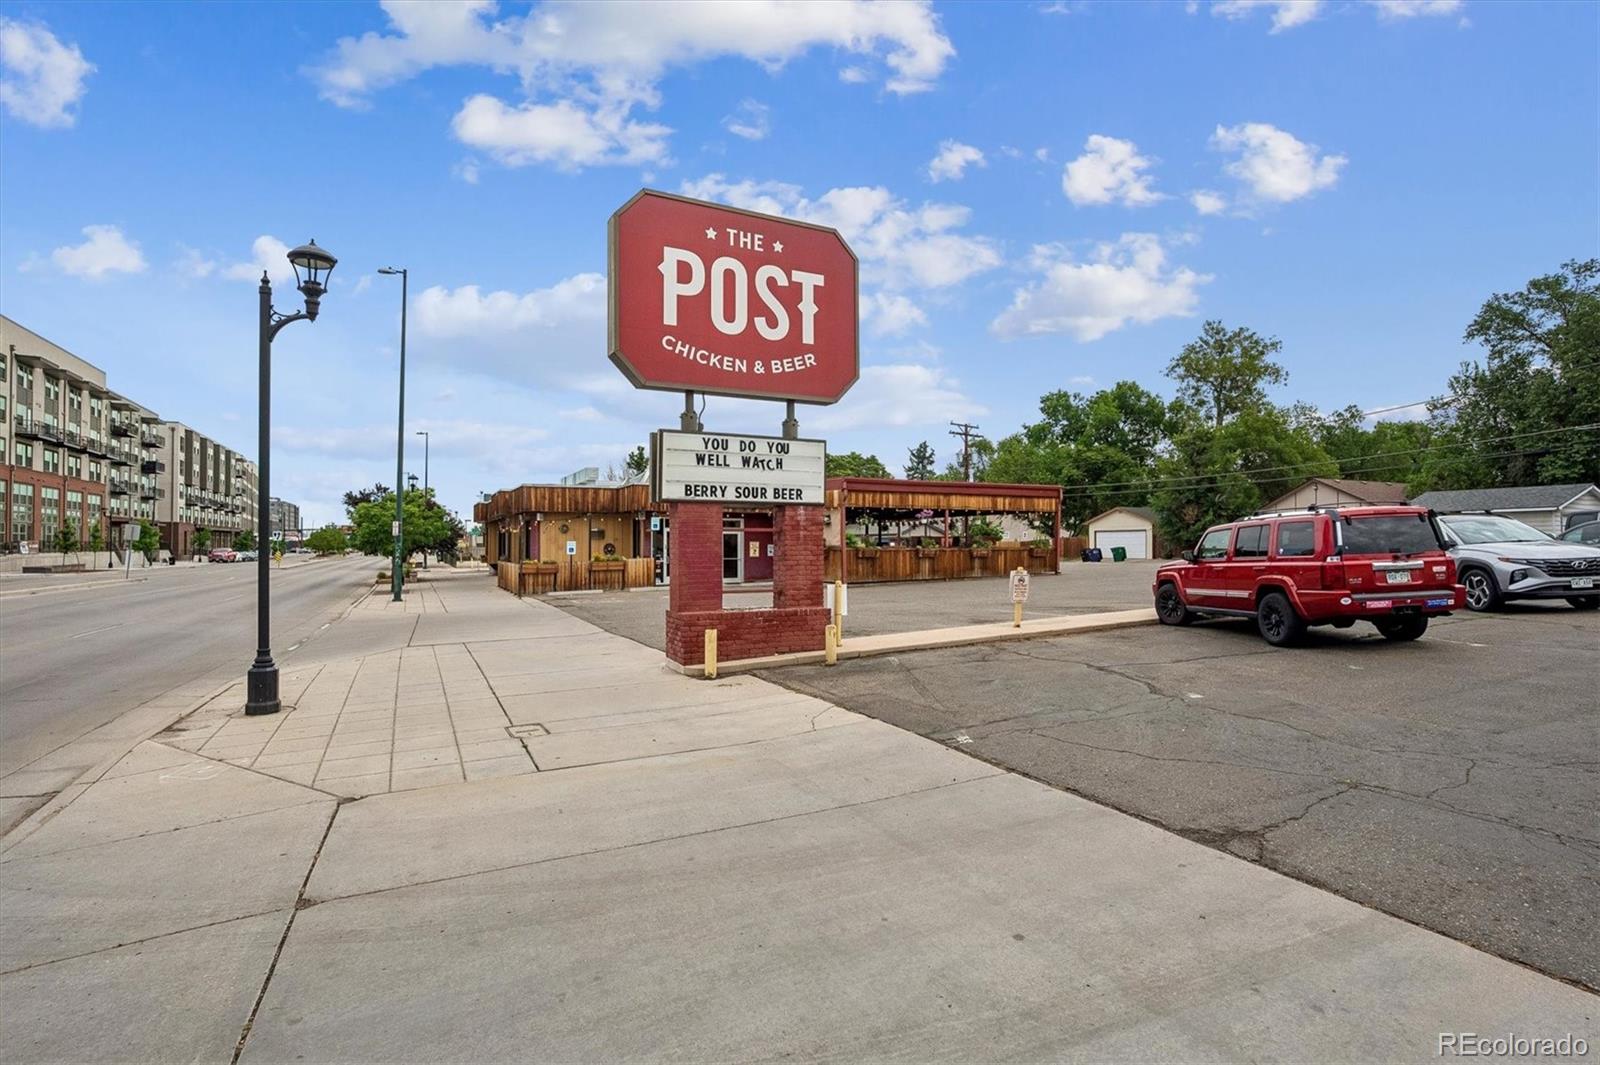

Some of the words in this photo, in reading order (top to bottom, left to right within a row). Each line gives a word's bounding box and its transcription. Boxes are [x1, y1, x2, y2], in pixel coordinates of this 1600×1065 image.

[727, 228, 764, 252] THE
[657, 246, 825, 345] POST
[661, 335, 748, 374] CHICKEN
[753, 360, 766, 375] &
[771, 353, 817, 374] BEER
[702, 437, 729, 451] YOU
[739, 440, 757, 453] DO
[767, 441, 791, 455] YOU
[696, 453, 730, 467] WELL
[741, 456, 784, 472] WATCH
[684, 484, 728, 498] BERRY
[734, 486, 768, 500] SOUR
[773, 487, 804, 501] BEER
